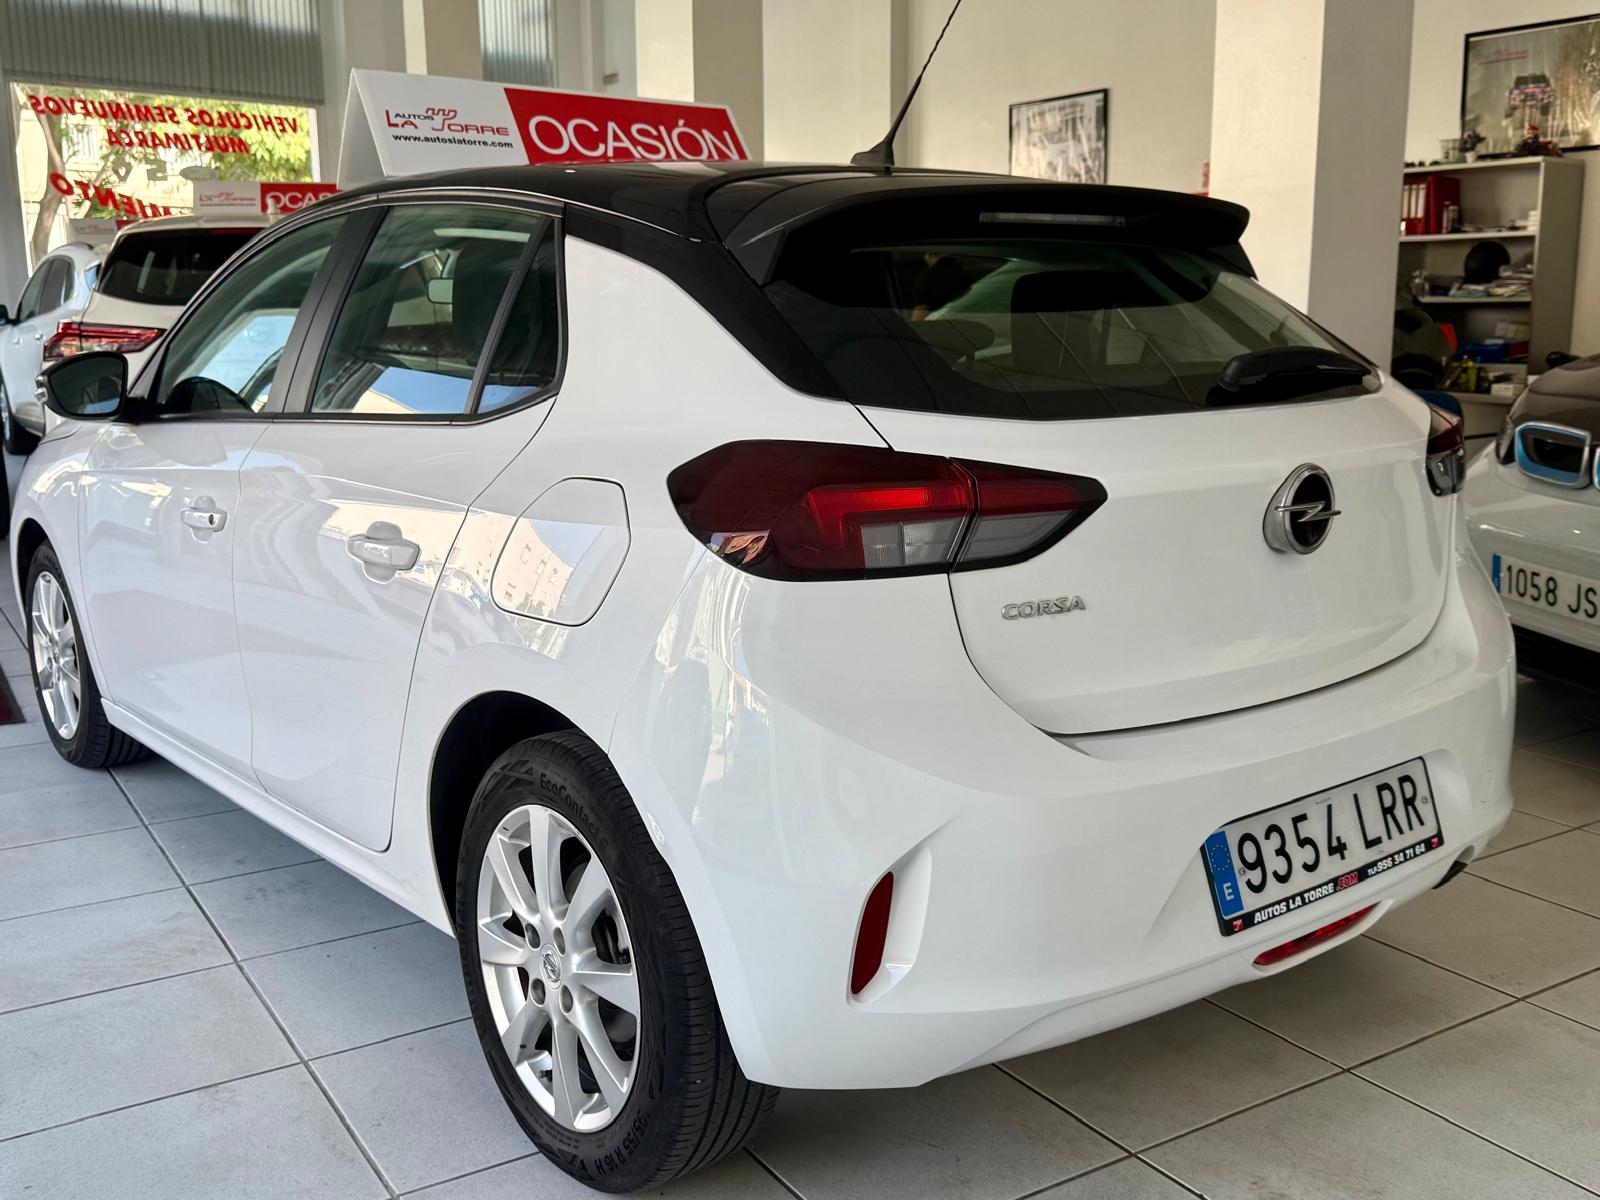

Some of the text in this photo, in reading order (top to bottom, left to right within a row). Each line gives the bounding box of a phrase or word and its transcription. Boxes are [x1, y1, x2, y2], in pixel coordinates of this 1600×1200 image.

[385, 109, 418, 129] LA
[394, 112, 435, 121] AUTOS
[391, 134, 514, 149] www.autoslatorre.com
[528, 115, 740, 161] OCASIÓN
[1506, 564, 1598, 619] 1058 JS
[1001, 595, 1086, 620] CORSA
[540, 772, 601, 841] EcoContact
[1237, 774, 1425, 894] 9354 LRR
[1394, 852, 1405, 865] 34
[1415, 843, 1426, 855] 64
[1222, 882, 1235, 901] E
[1254, 902, 1288, 924] AUTOS
[1289, 895, 1302, 910] LA
[1304, 883, 1335, 904] TORRE
